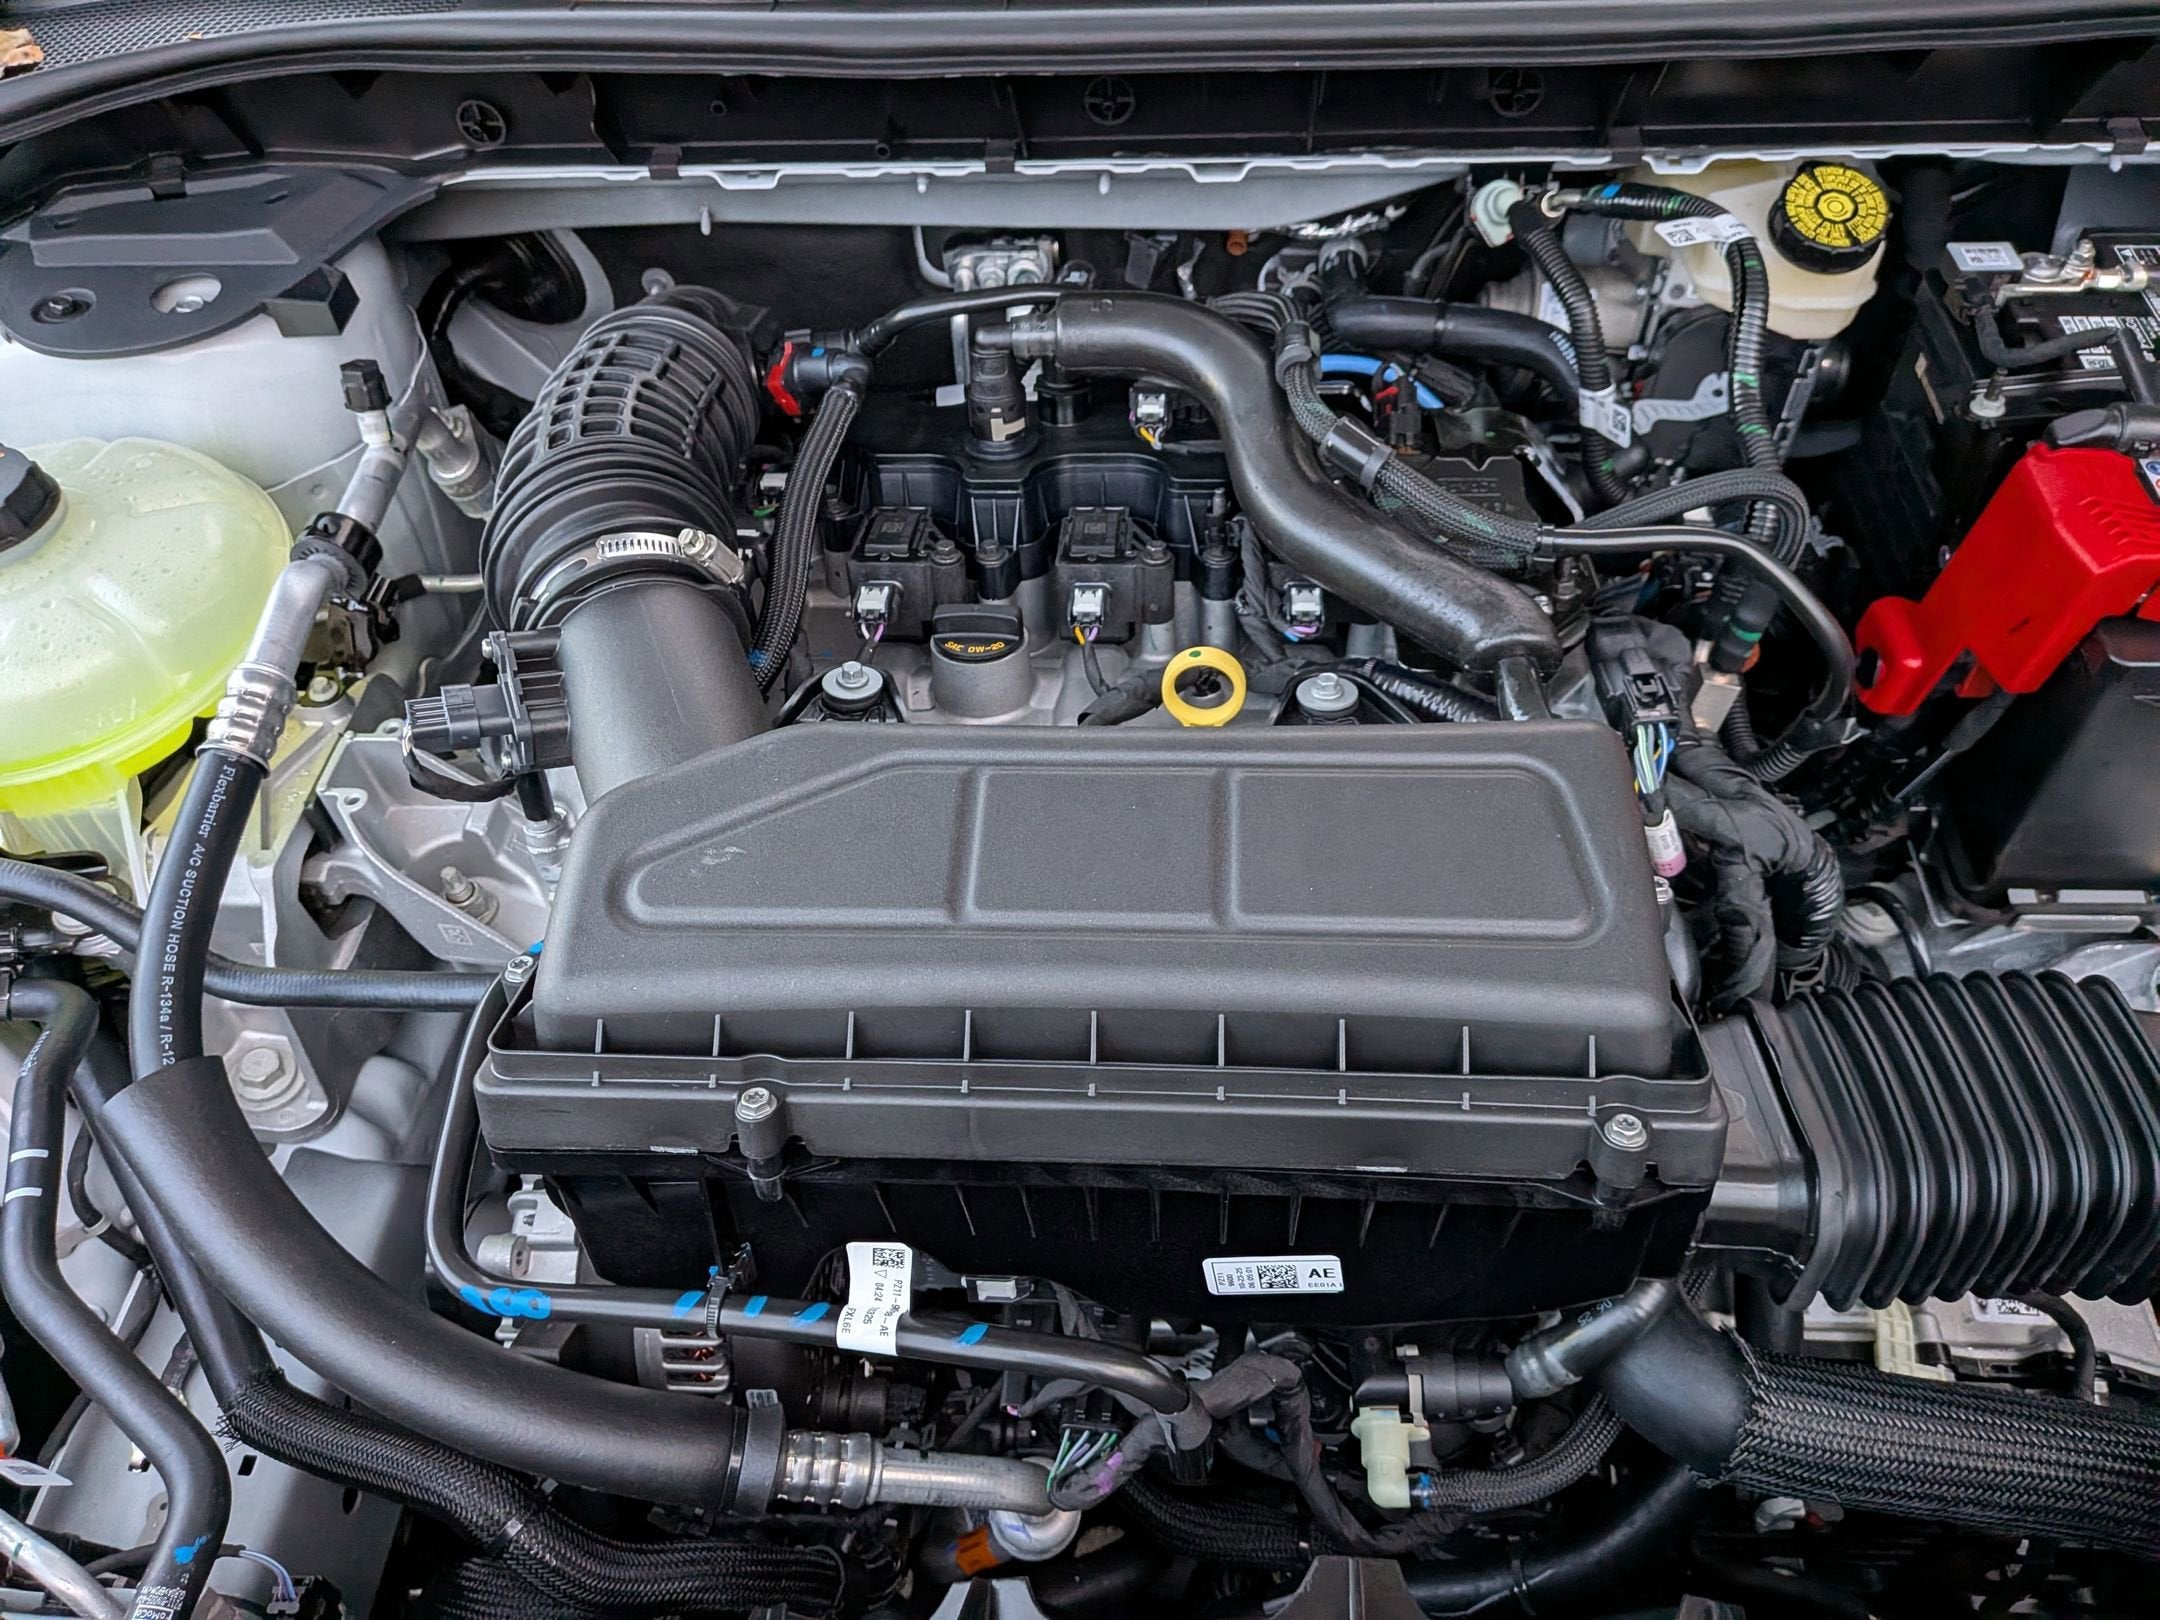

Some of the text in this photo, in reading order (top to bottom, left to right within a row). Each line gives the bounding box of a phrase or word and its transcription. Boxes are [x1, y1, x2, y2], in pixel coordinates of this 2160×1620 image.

[945, 641, 1005, 653] SAE 0W-20
[198, 764, 236, 838] Flexbarrier
[189, 843, 206, 866] A/C
[170, 869, 197, 930] SUCTION
[162, 933, 181, 972] HOSE
[160, 976, 174, 1022] R-134a
[1309, 1268, 1336, 1278] AE
[842, 1307, 856, 1334] FXL6E
